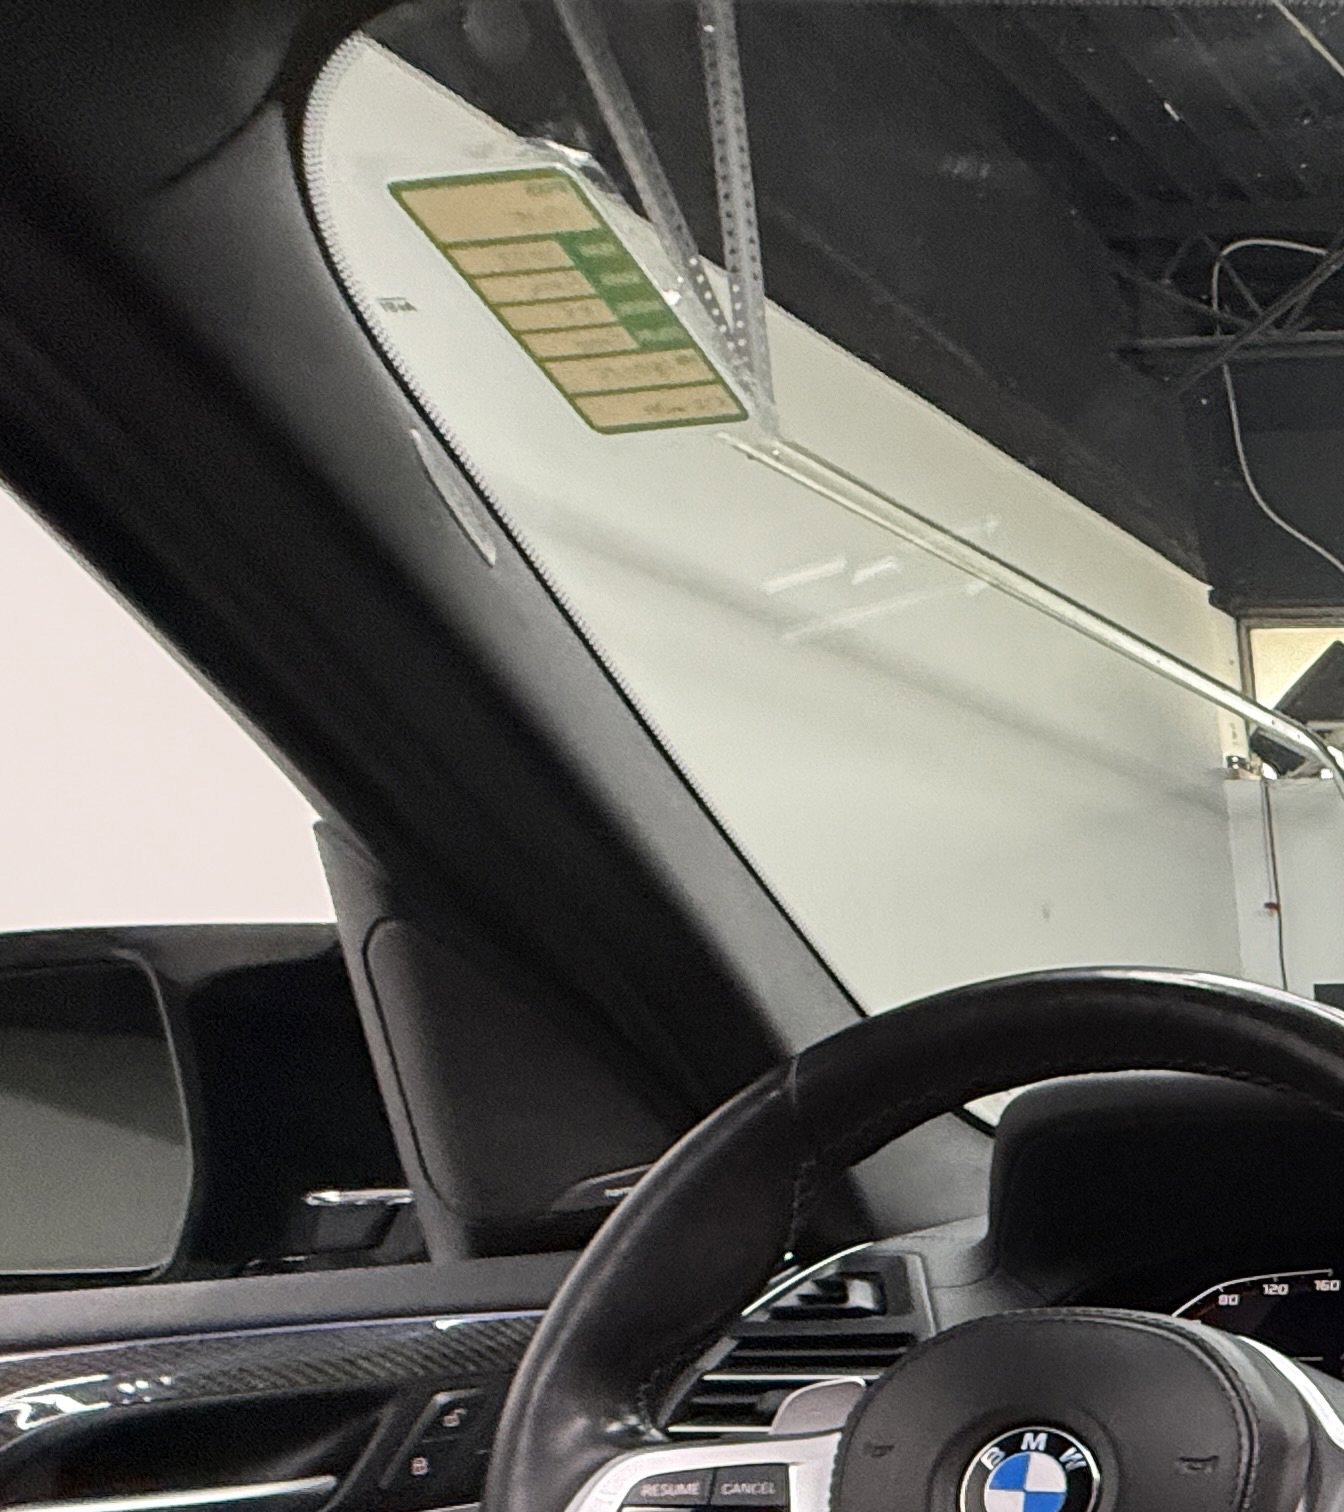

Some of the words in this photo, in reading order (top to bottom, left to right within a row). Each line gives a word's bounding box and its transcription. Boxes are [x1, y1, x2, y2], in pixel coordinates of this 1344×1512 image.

[1263, 1284, 1289, 1296] 120
[1314, 1280, 1341, 1292] 160
[1218, 1294, 1240, 1306] 80
[980, 1432, 1087, 1471] BMW
[641, 1482, 700, 1497] RESUME
[720, 1482, 777, 1496] CANCEL
